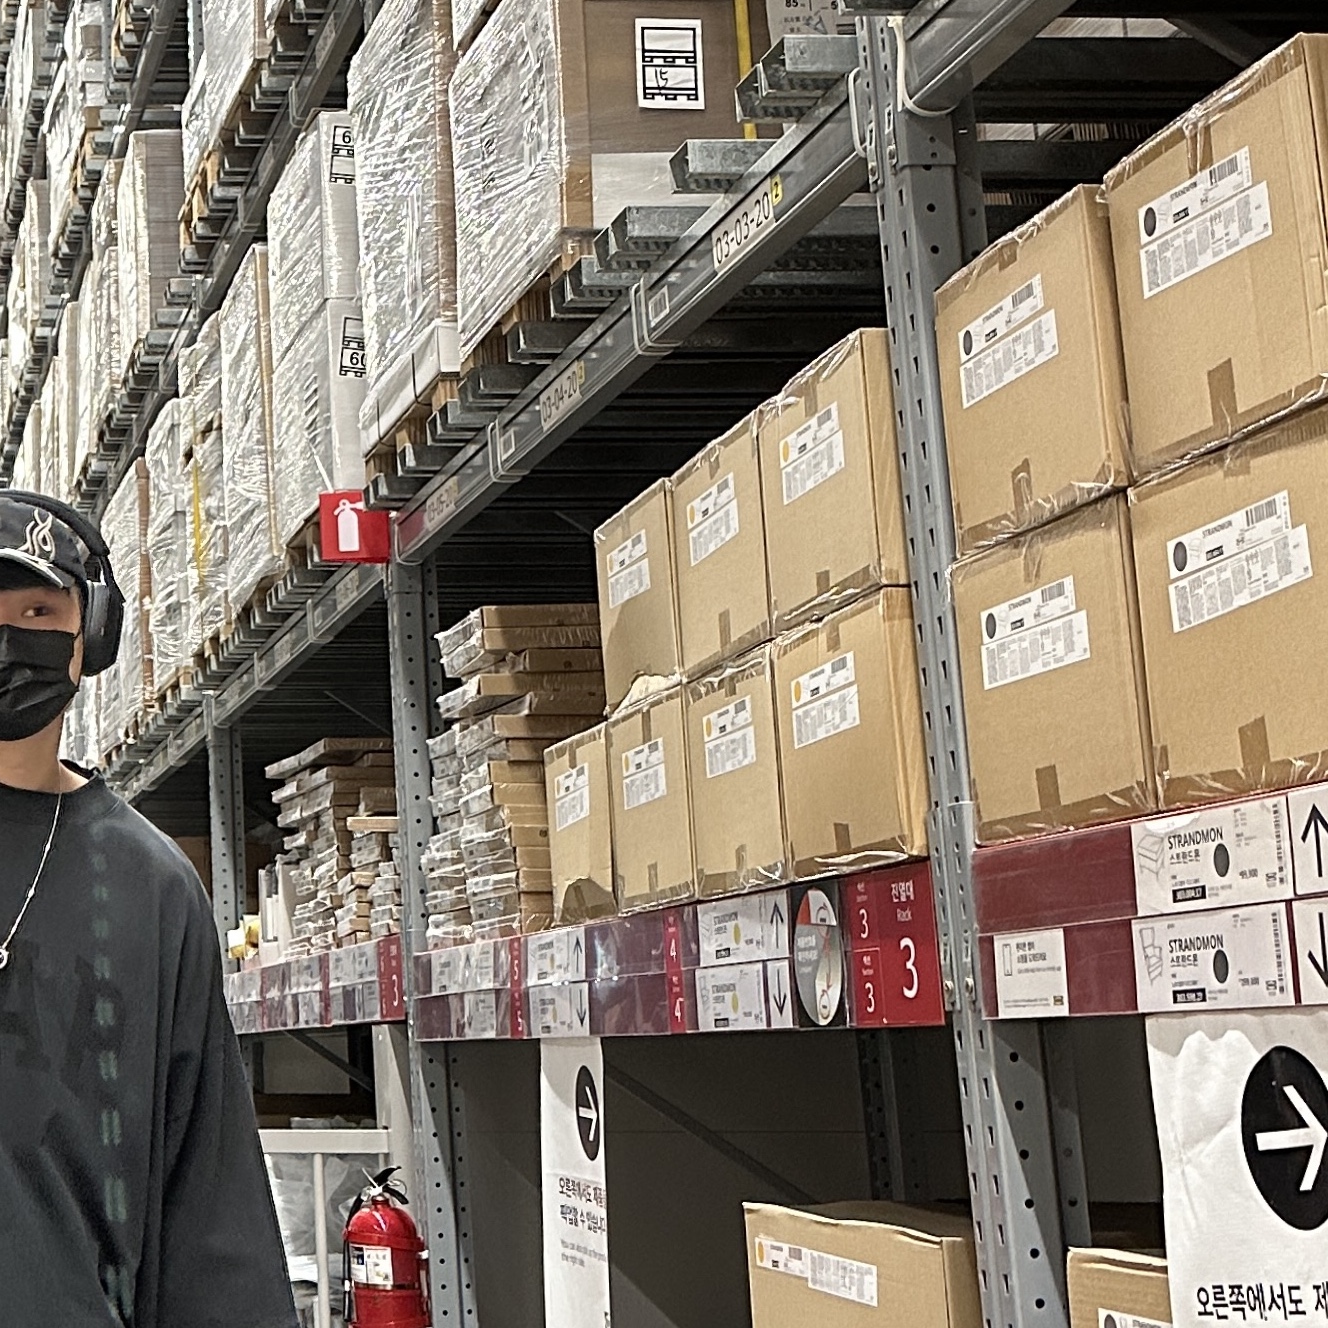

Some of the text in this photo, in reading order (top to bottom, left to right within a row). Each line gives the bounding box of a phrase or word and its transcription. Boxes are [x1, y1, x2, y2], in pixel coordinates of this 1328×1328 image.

[715, 191, 770, 264] 03-03-20
[542, 370, 578, 422] 03-04-20
[1167, 826, 1224, 850] STRANDMON
[891, 879, 915, 903] 진열대
[858, 908, 869, 939] 3
[896, 905, 913, 922] Rack
[669, 938, 677, 962] 4
[1168, 934, 1224, 954] STRANDMON
[899, 937, 919, 999] 3
[392, 974, 399, 1007] 3
[864, 981, 875, 1013] 3
[585, 1210, 606, 1235] 있습니
[1196, 1282, 1308, 1321] 오른쪽에서도
